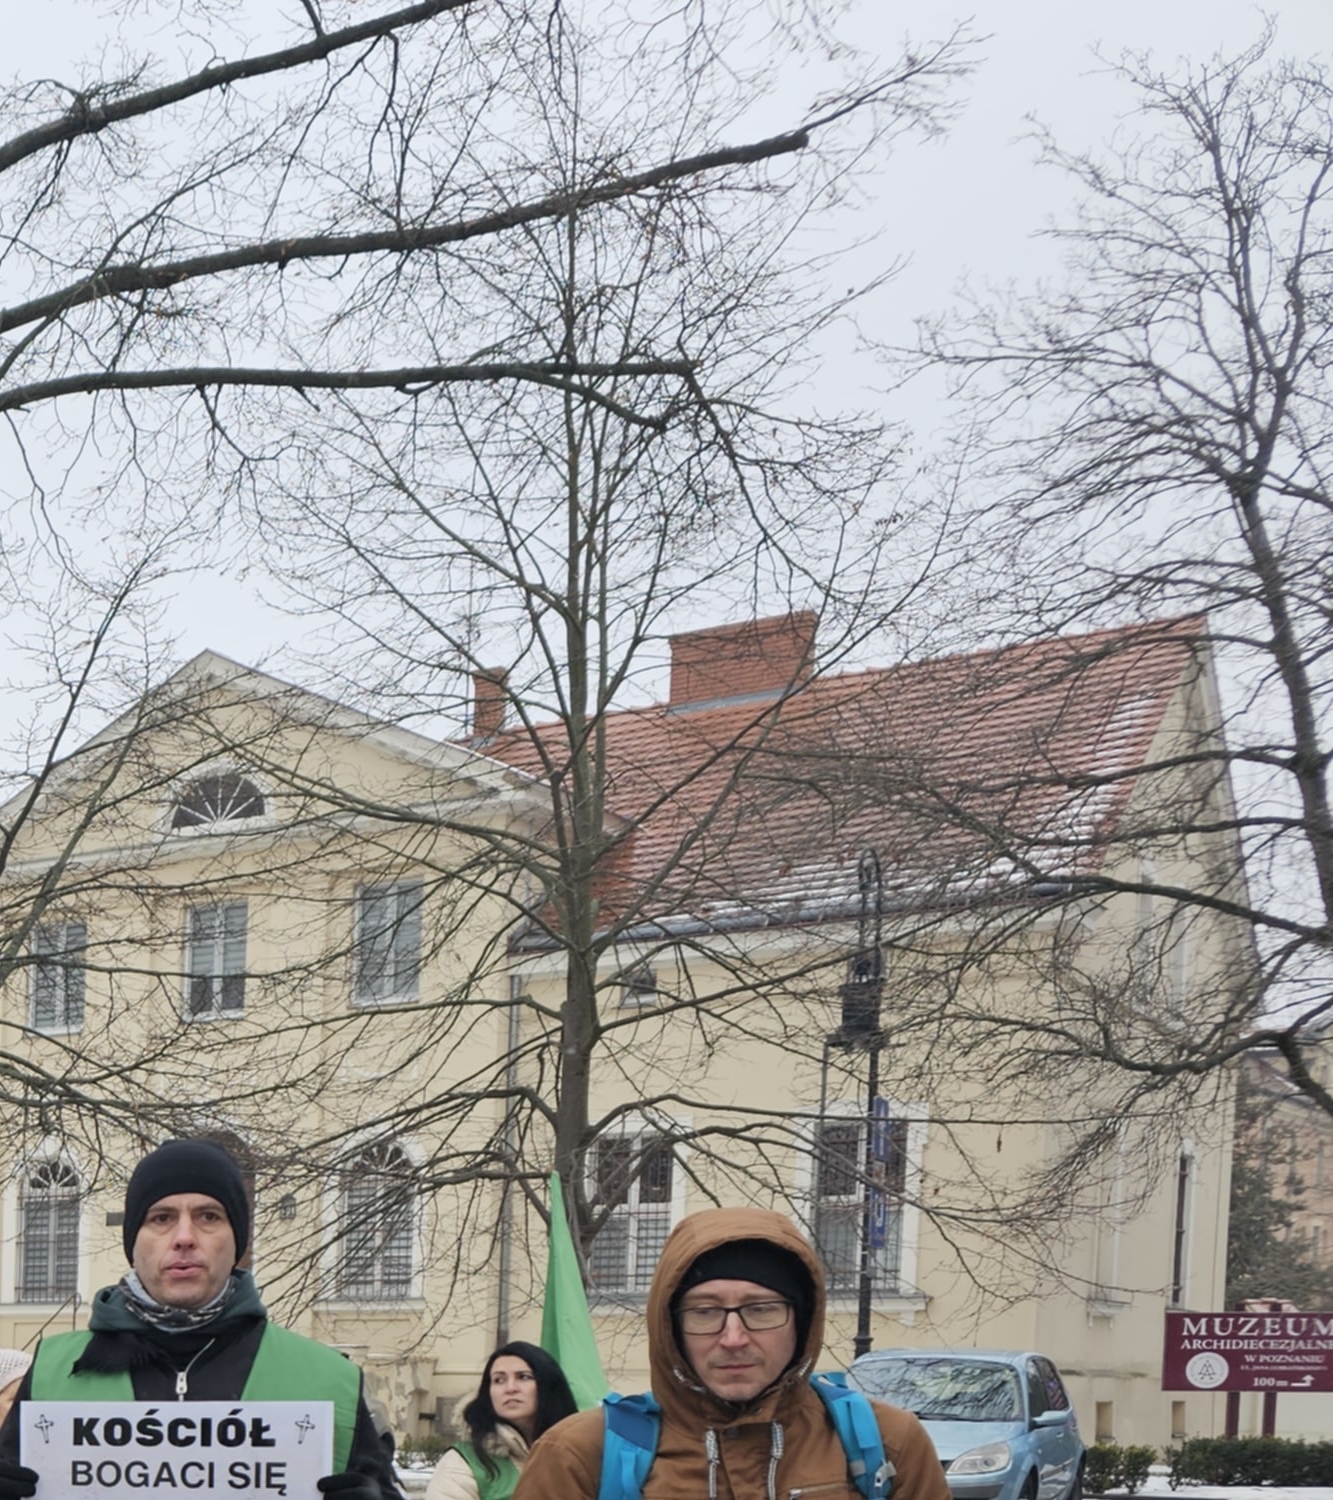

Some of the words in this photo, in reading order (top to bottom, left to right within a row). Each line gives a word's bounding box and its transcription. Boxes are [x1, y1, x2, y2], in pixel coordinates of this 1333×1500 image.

[1181, 1317, 1333, 1336] MUZEUM
[1244, 1354, 1257, 1363] W
[1259, 1354, 1325, 1364] POZNANIU
[72, 1408, 276, 1448] KOŚCIÓŁ
[71, 1460, 215, 1489] BOGACI
[227, 1461, 287, 1496] SIĘ
